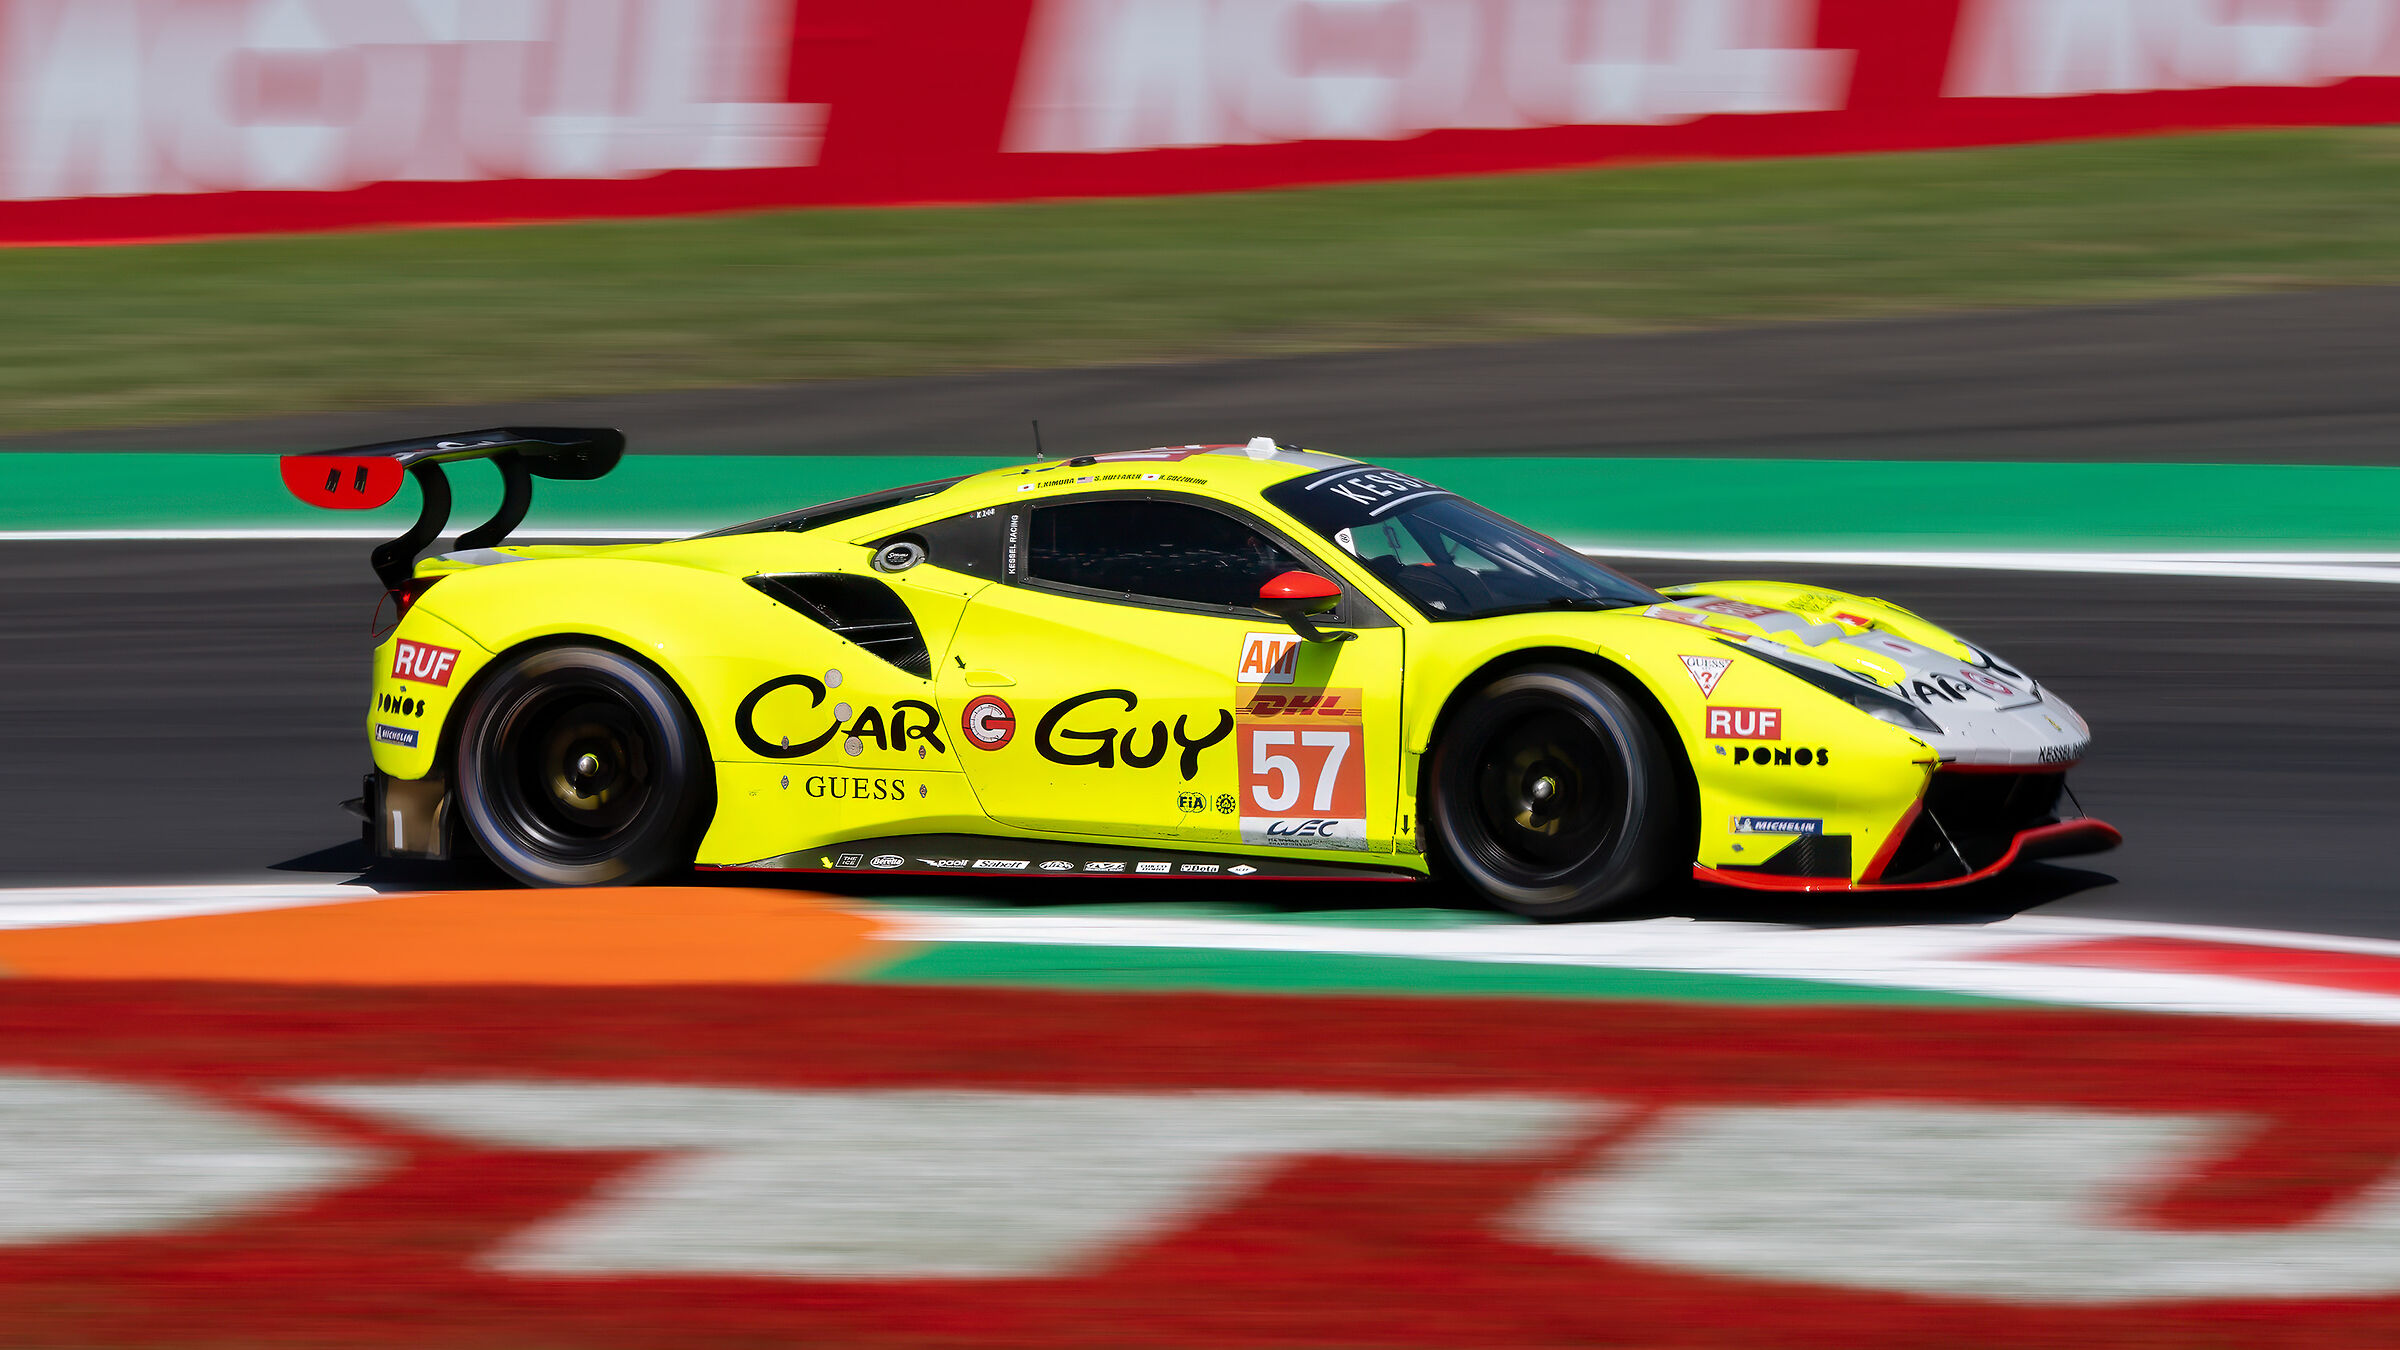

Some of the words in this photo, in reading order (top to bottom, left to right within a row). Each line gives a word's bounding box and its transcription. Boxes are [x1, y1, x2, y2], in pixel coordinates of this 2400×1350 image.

[1009, 514, 1019, 543] RACING
[1008, 544, 1017, 575] KESSEL
[395, 643, 455, 680] RUF
[1241, 640, 1297, 674] AM
[1686, 657, 1725, 669] GUESS
[377, 692, 426, 718] PONOS
[1250, 694, 1347, 715] DHL
[1711, 709, 1777, 736] RUF
[1734, 746, 1829, 766] PONOS
[1252, 730, 1350, 812] 57
[805, 775, 906, 801] GUESS
[1266, 820, 1338, 837] WEC
[1755, 821, 1816, 832] MICHELIN
